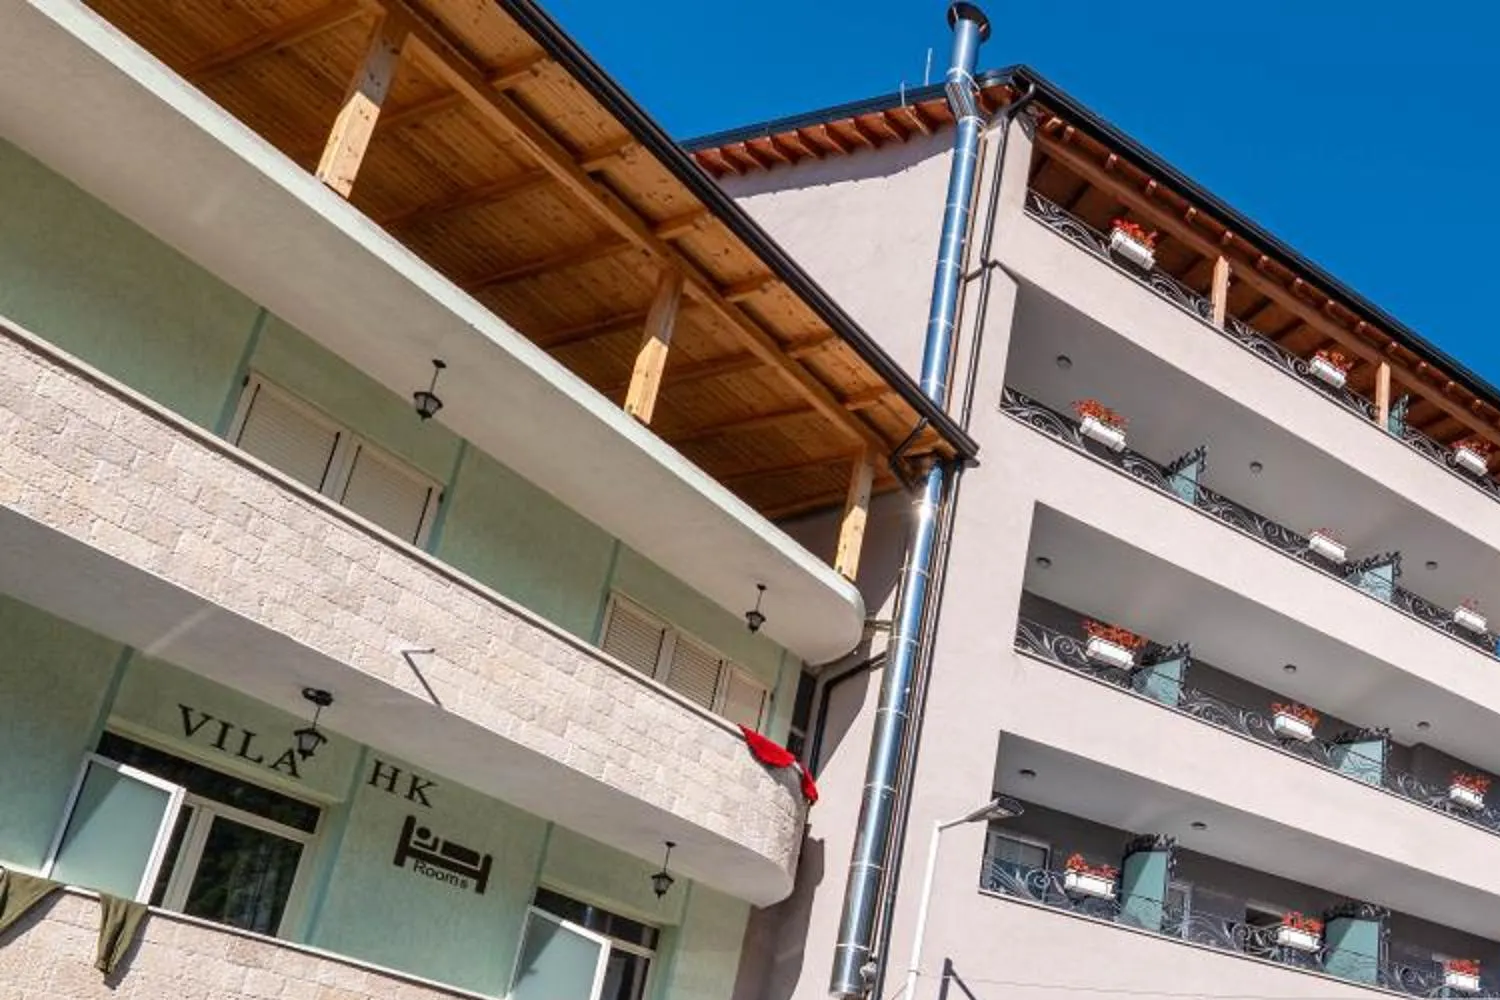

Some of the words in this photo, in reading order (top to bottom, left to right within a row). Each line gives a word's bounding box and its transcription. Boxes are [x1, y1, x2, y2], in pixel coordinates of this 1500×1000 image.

[177, 703, 304, 780] VILA
[368, 759, 439, 808] HK
[413, 860, 469, 890] Rooms
